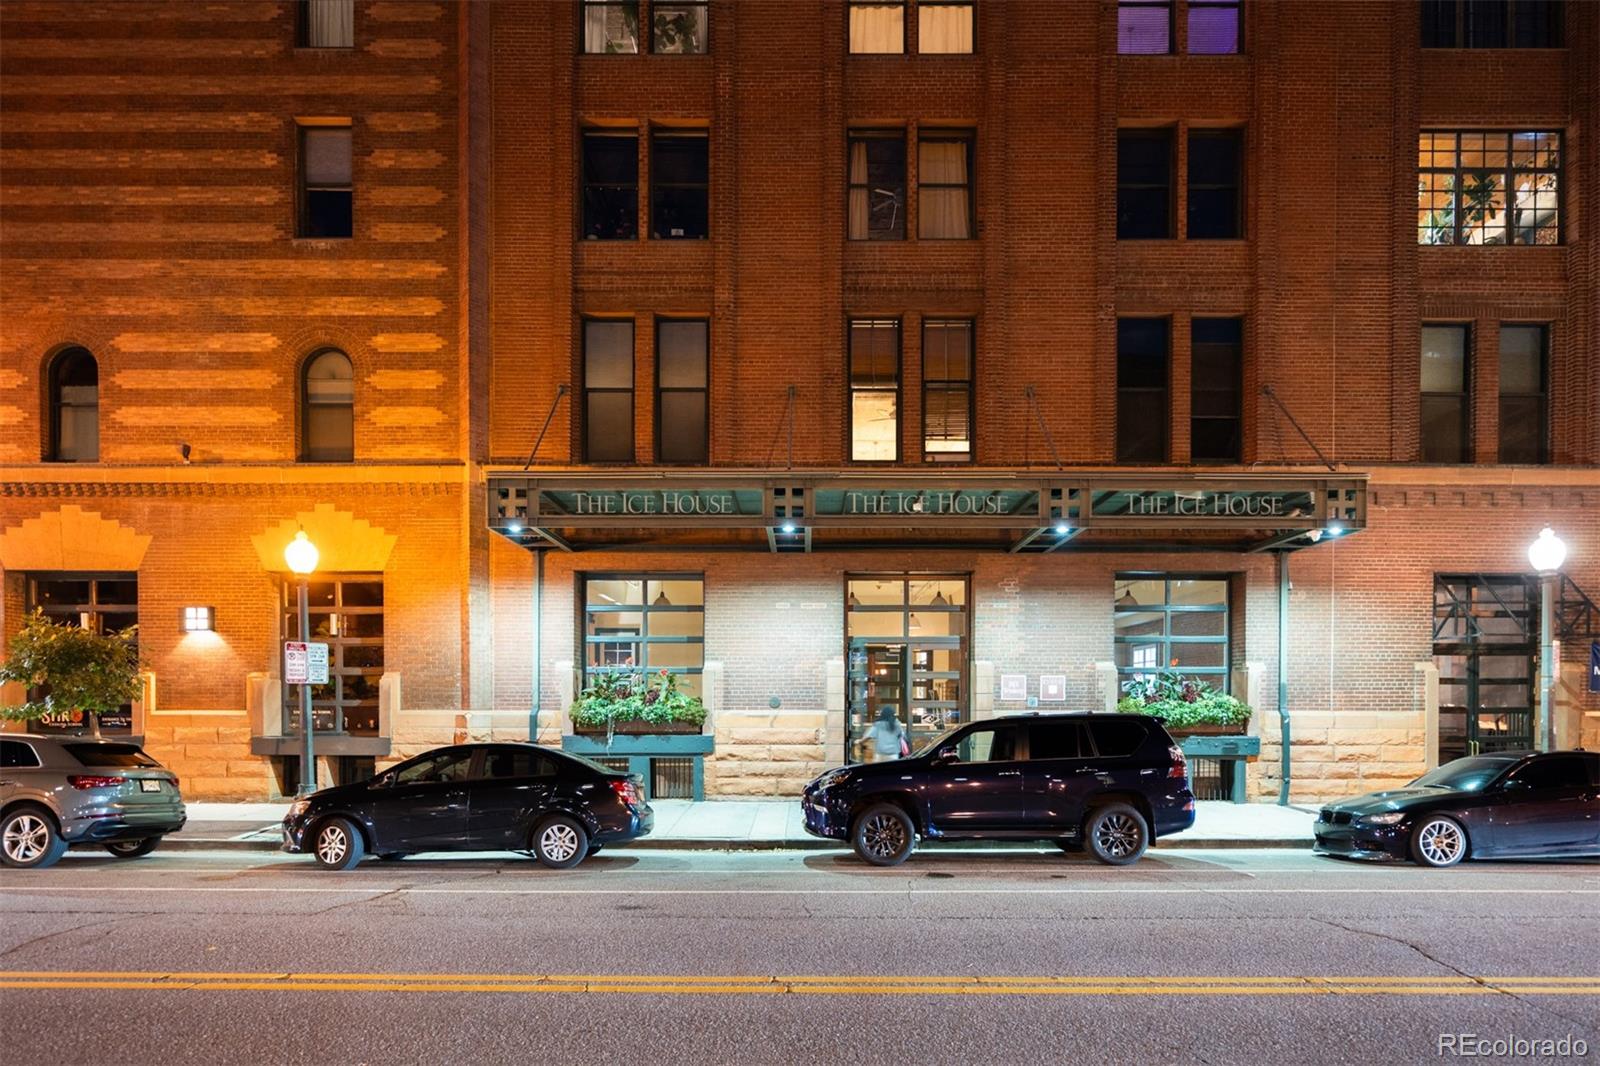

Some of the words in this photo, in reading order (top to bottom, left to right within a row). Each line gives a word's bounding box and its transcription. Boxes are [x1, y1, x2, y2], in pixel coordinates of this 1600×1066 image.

[571, 492, 616, 514] THE
[621, 492, 656, 514] ICE
[661, 492, 733, 514] HOUSE
[846, 492, 892, 514] THE
[897, 492, 931, 514] ICE
[937, 492, 1009, 514] HOUSE
[1124, 493, 1169, 515] THE
[1174, 493, 1207, 515] ICE
[1213, 493, 1283, 515] HOUSE
